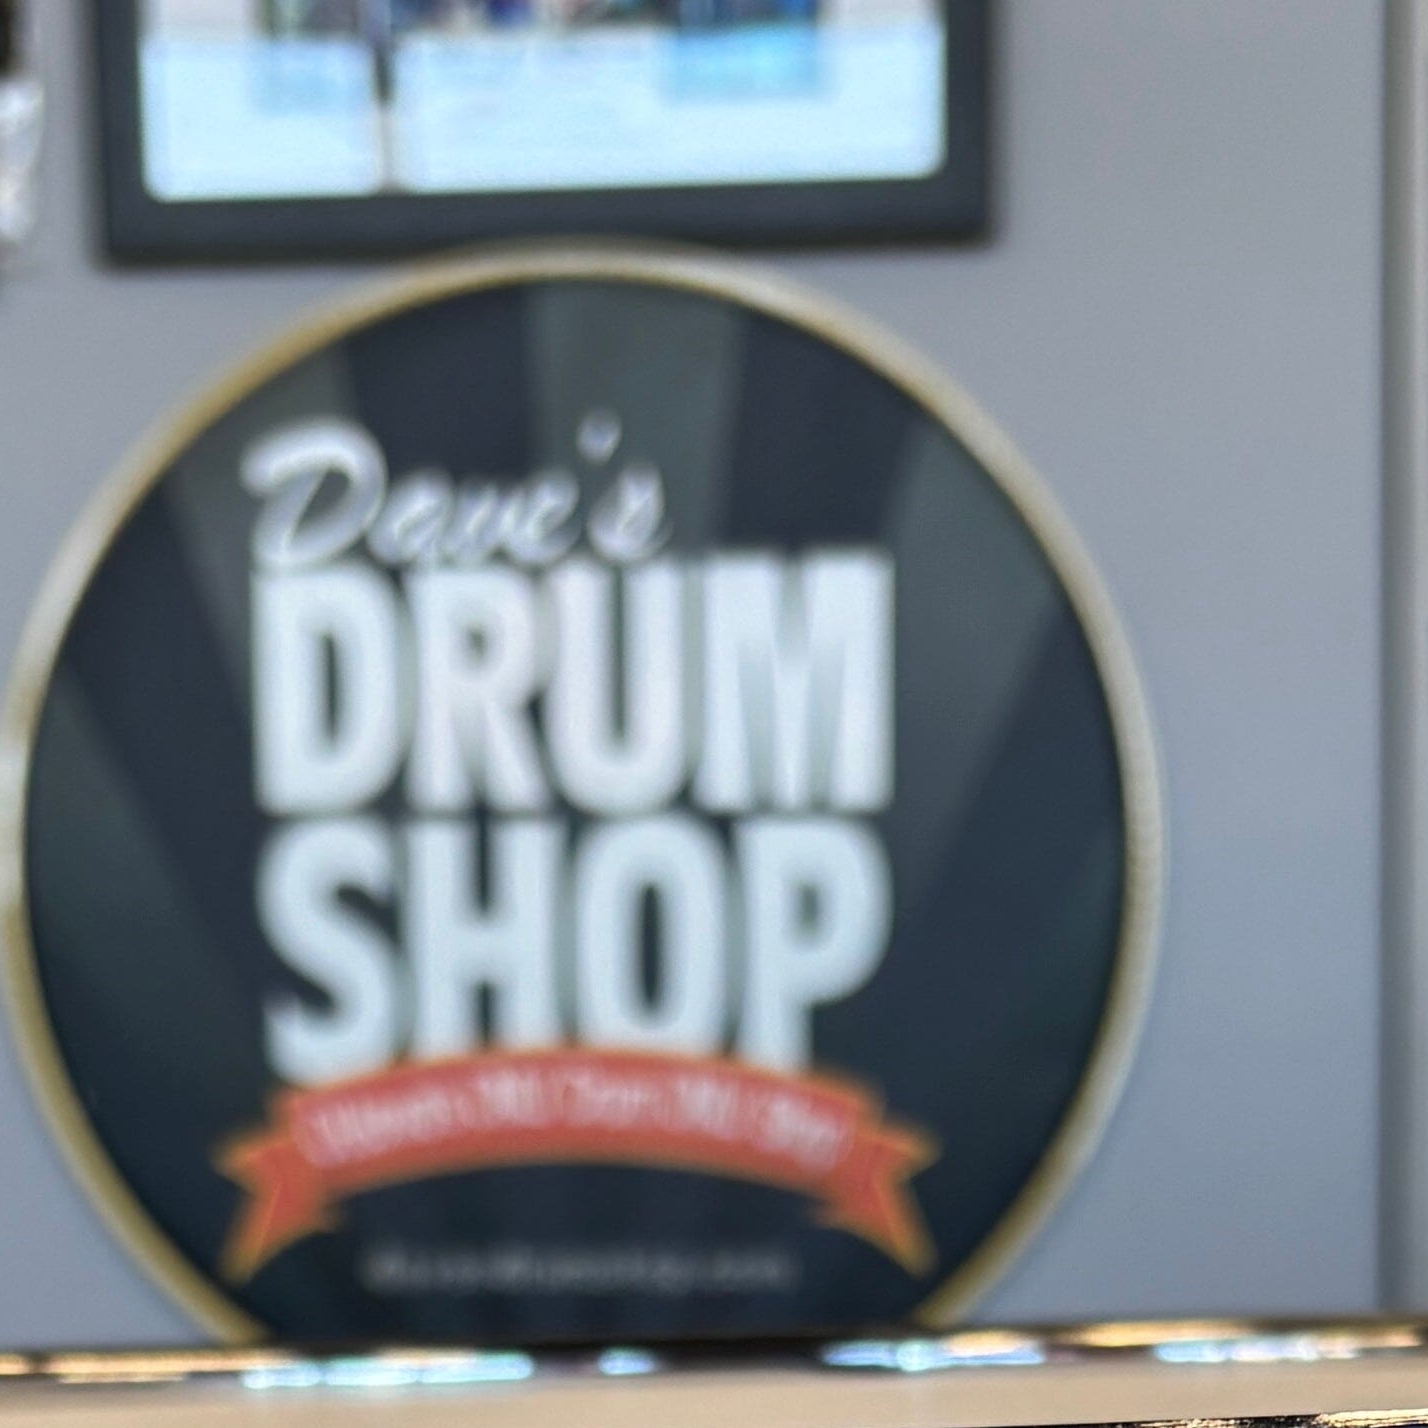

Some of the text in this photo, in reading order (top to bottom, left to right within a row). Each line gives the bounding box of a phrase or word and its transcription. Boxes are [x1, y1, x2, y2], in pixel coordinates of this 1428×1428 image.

[240, 412, 672, 571] Dave's
[250, 547, 896, 817] DRUM
[255, 812, 896, 1090] SHOP
